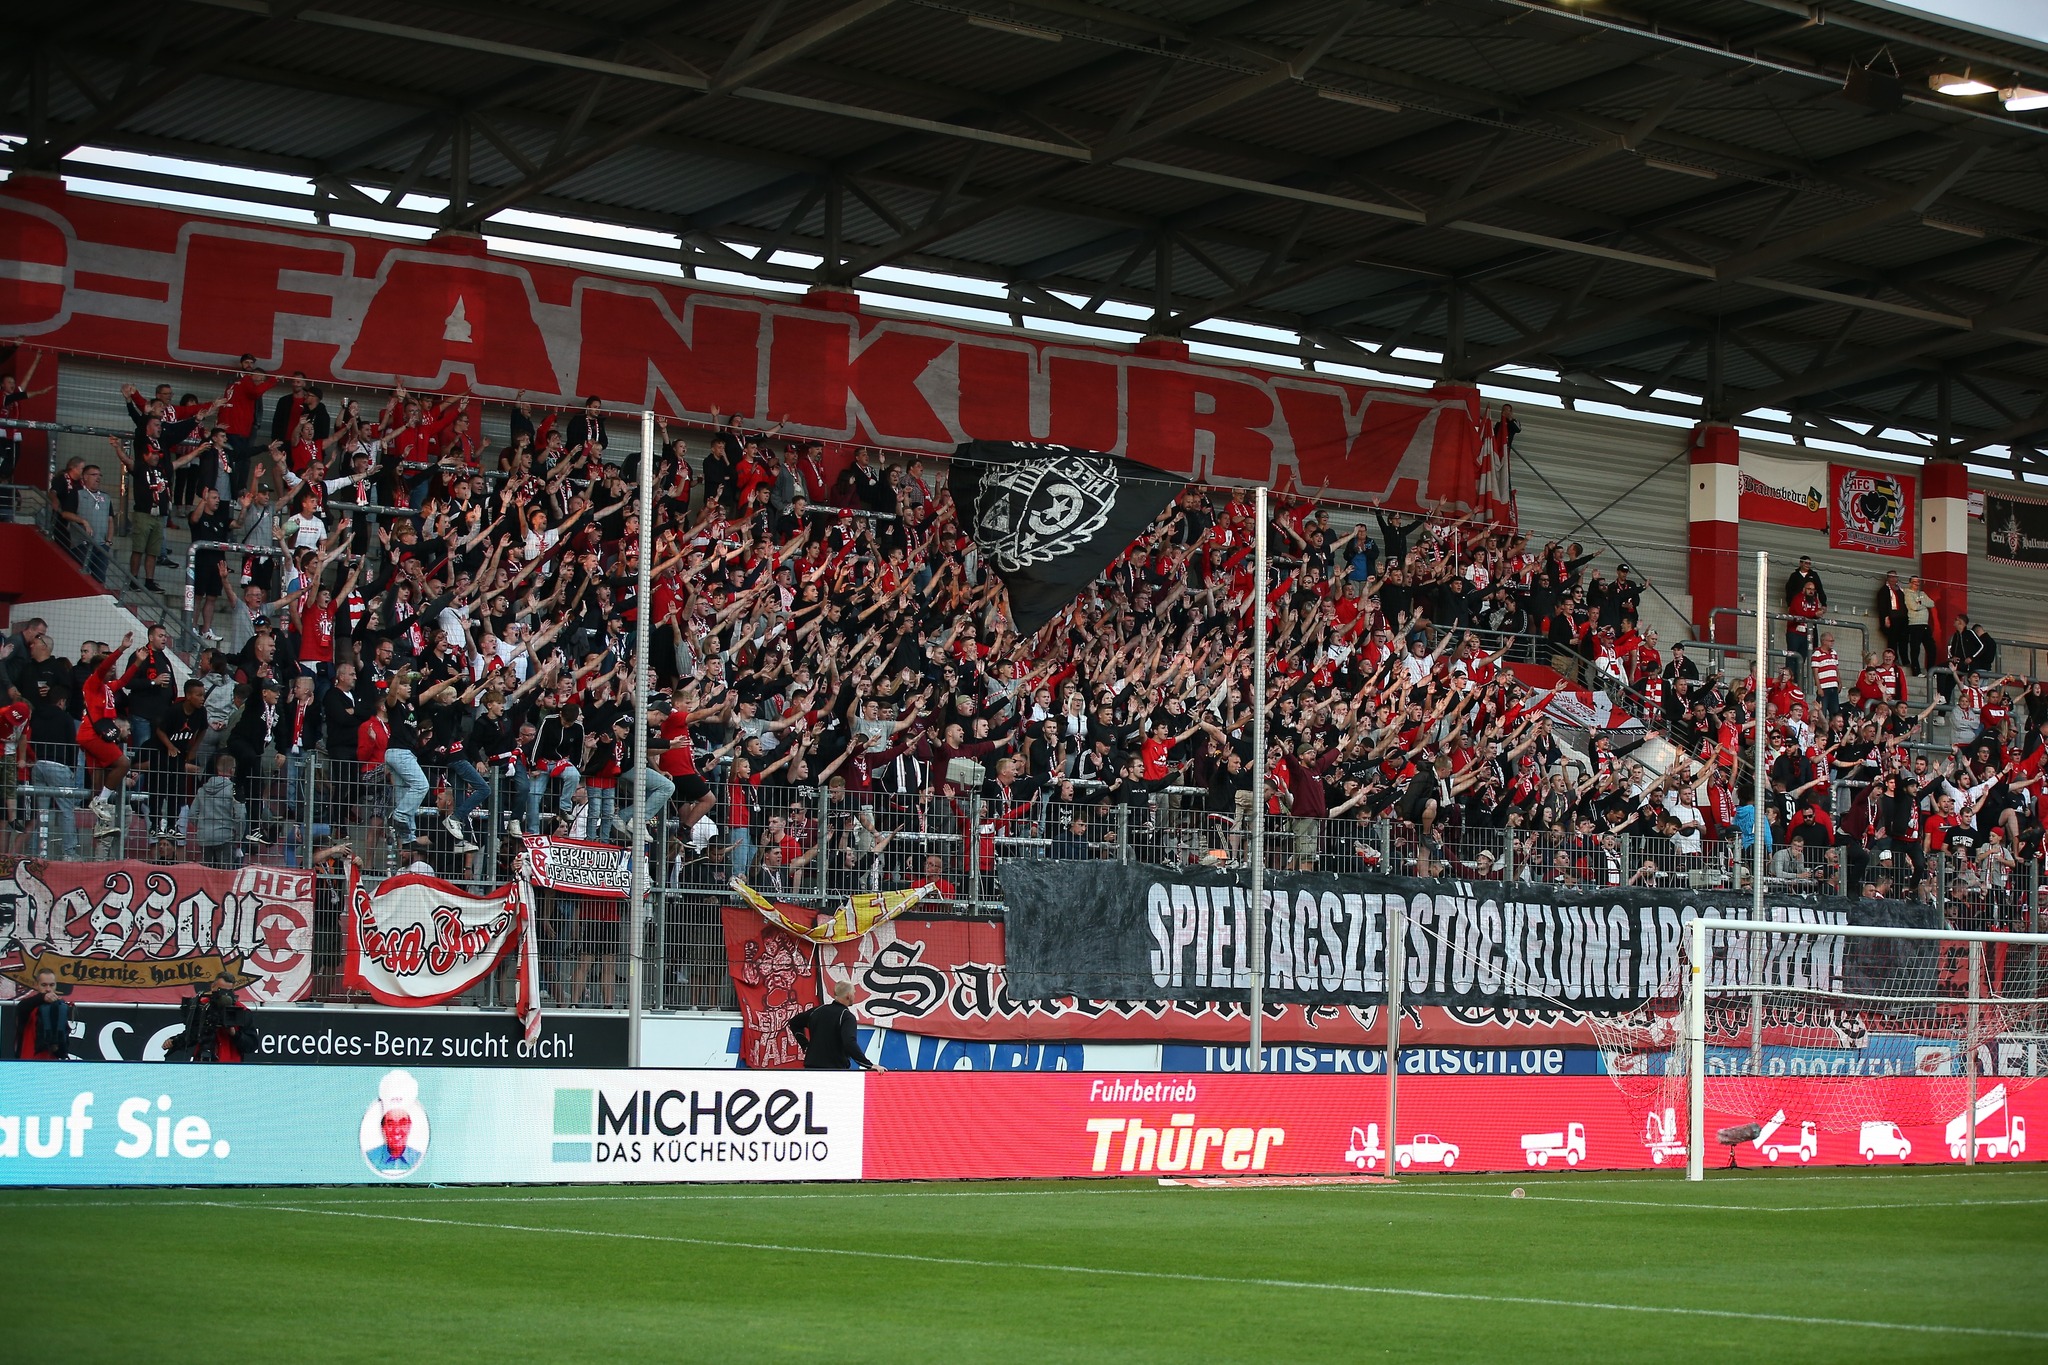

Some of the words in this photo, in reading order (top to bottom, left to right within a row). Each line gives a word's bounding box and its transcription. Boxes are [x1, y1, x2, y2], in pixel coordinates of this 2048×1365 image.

[1744, 474, 1807, 504] Braunsbedra
[1850, 478, 1870, 490] HFC
[522, 836, 545, 847] HFC
[550, 847, 620, 870] SEKTION
[254, 869, 311, 900] HFC
[545, 863, 631, 887] WEISSENFELS
[60, 960, 146, 985] chemie
[150, 961, 212, 984] halle
[254, 1029, 433, 1057] ercedes-Benz
[441, 1032, 509, 1058] sucht
[1090, 1079, 1197, 1102] Fuhrbetrieb
[0, 1091, 94, 1158] auf
[114, 1094, 231, 1158] Sie.
[596, 1142, 642, 1162] DAS
[654, 1140, 829, 1162] KÜCHENSTUDIO
[1086, 1113, 1285, 1172] Thürer
